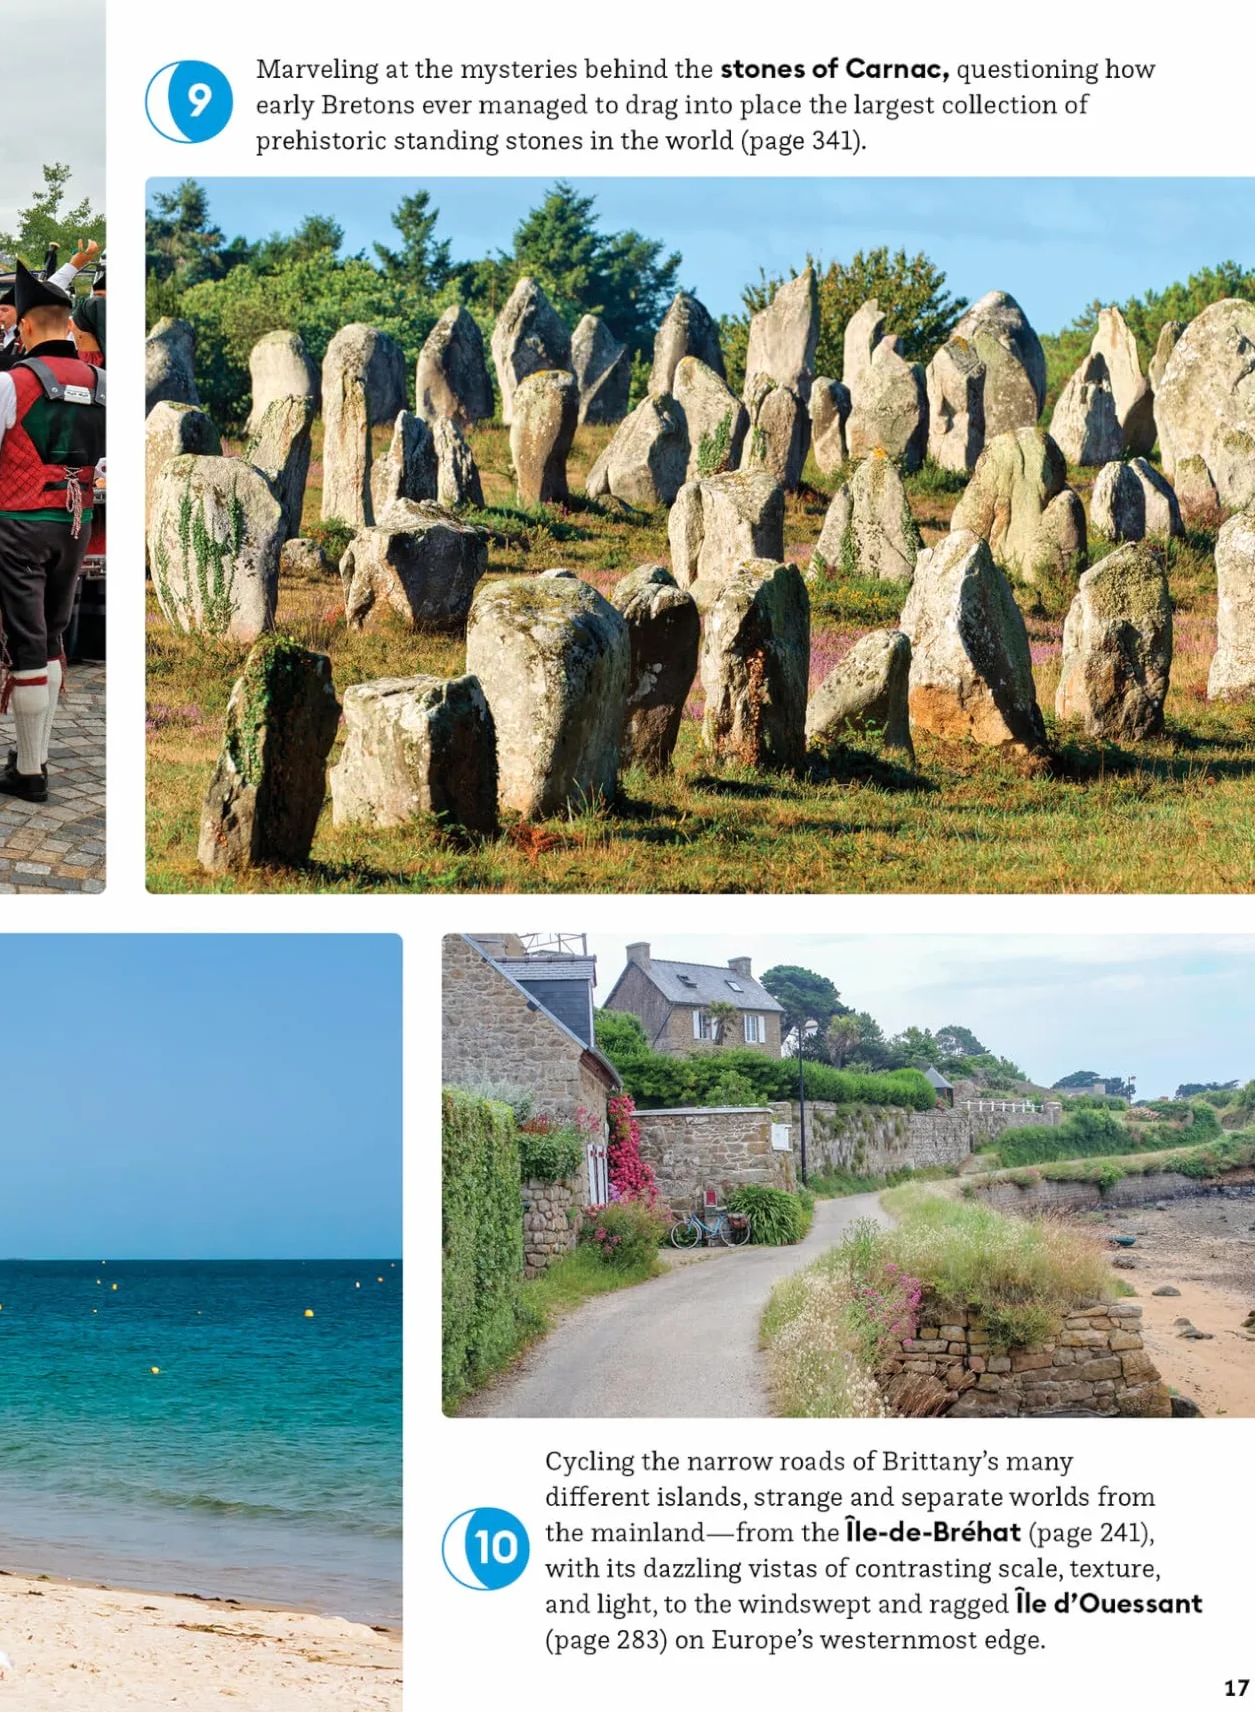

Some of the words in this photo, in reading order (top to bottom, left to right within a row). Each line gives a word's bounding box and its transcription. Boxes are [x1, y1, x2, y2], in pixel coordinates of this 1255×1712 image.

[256, 57, 379, 85] Marveling
[386, 60, 409, 79] at
[414, 57, 453, 79] the
[460, 58, 578, 85] mysteries
[583, 57, 669, 79] behind
[674, 57, 713, 79] the
[720, 59, 806, 79] stones
[811, 56, 839, 79] of
[845, 57, 950, 83] Carnac,
[957, 58, 1099, 85] questioning
[1105, 57, 1157, 79] how
[189, 83, 212, 117] 9
[256, 93, 315, 121] early
[321, 94, 415, 115] Bretons
[422, 99, 473, 115] ever
[478, 93, 588, 121] managed
[594, 96, 619, 115] to
[625, 93, 679, 121] drag
[684, 94, 733, 115] into
[739, 93, 802, 121] place
[808, 93, 847, 115] the
[853, 93, 935, 121] largest
[942, 93, 1058, 115] collection
[1064, 92, 1091, 115] of
[255, 128, 387, 157] prehistoric
[393, 129, 499, 157] standing
[505, 132, 583, 151] stones
[590, 130, 614, 151] in
[620, 128, 659, 151] the
[664, 128, 734, 151] world
[741, 128, 805, 157] (page
[812, 128, 867, 156] 341).
[545, 1449, 635, 1477] Cycling
[641, 1449, 680, 1471] the
[687, 1456, 774, 1471] narrow
[779, 1449, 845, 1471] roads
[852, 1449, 878, 1471] of
[882, 1449, 999, 1477] Brittany’s
[1006, 1456, 1074, 1477] many
[545, 1484, 650, 1507] different
[656, 1485, 748, 1511] islands,
[753, 1488, 843, 1513] strange
[850, 1485, 895, 1507] and
[901, 1488, 1004, 1513] separate
[1008, 1485, 1090, 1507] worlds
[1097, 1484, 1156, 1507] from
[545, 1521, 584, 1543] the
[591, 1520, 795, 1543] mainland—from
[801, 1521, 840, 1543] the
[844, 1514, 1022, 1543] Île-de-Bréhat
[1028, 1521, 1093, 1549] (page
[1100, 1521, 1155, 1548] 241),
[475, 1530, 518, 1563] 10
[544, 1556, 601, 1578] with
[606, 1558, 636, 1578] its
[643, 1556, 742, 1585] dazzling
[748, 1558, 818, 1578] vistas
[825, 1556, 851, 1578] of
[855, 1558, 992, 1585] contrasting
[998, 1556, 1064, 1583] scale,
[1069, 1560, 1161, 1582] texture,
[545, 1592, 591, 1614] and
[597, 1592, 658, 1620] light,
[663, 1596, 687, 1614] to
[694, 1592, 732, 1614] the
[737, 1592, 871, 1620] windswept
[878, 1592, 923, 1614] and
[929, 1592, 1010, 1620] ragged
[1014, 1585, 1047, 1614] Île
[1053, 1591, 1203, 1614] d’Ouessant
[545, 1628, 610, 1656] (page
[617, 1628, 667, 1656] 283)
[675, 1634, 705, 1650] on
[711, 1628, 814, 1656] Europe’s
[819, 1631, 978, 1650] westernmost
[984, 1628, 1046, 1656] edge.
[1224, 1678, 1250, 1697] 17
